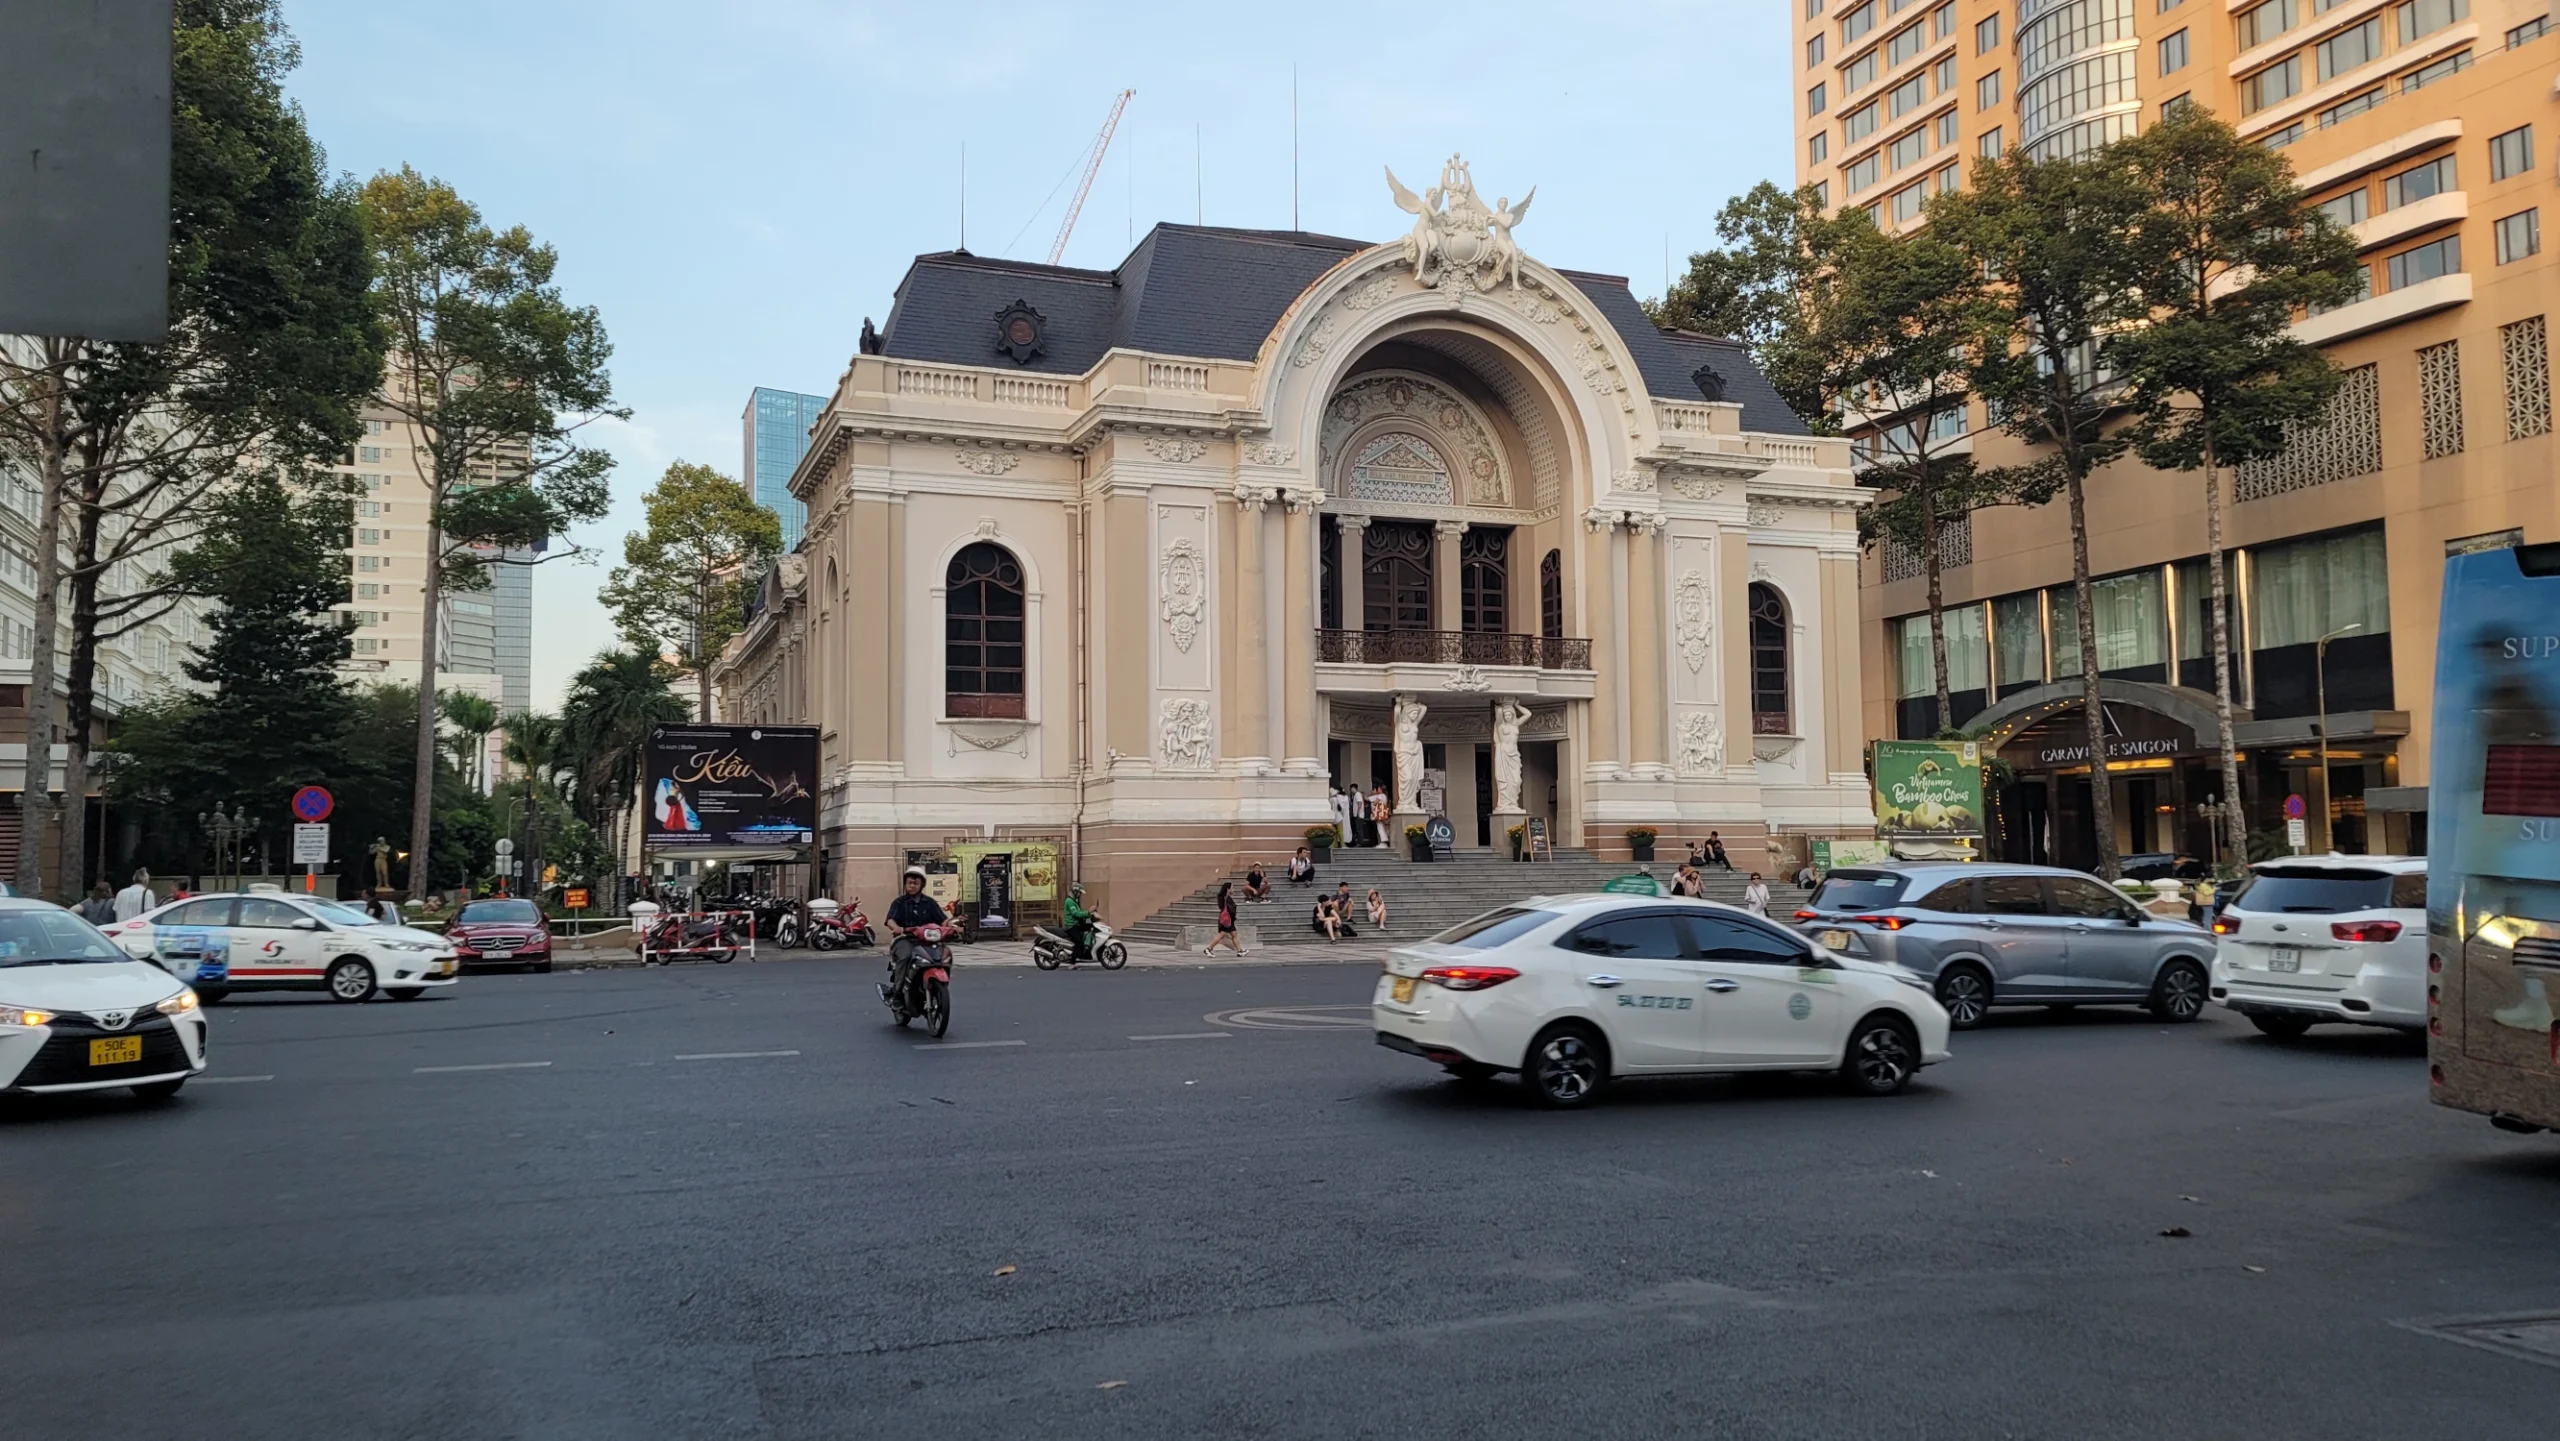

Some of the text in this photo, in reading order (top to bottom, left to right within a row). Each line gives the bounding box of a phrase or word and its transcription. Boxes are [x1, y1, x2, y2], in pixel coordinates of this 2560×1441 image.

[2121, 738, 2179, 756] SAIGON
[672, 748, 752, 783] Kiều
[1908, 773, 1953, 789] Vietnamese
[1892, 783, 1970, 803] Bamboo Circus
[104, 1040, 127, 1051] 50E
[97, 1050, 136, 1064] 111.19
